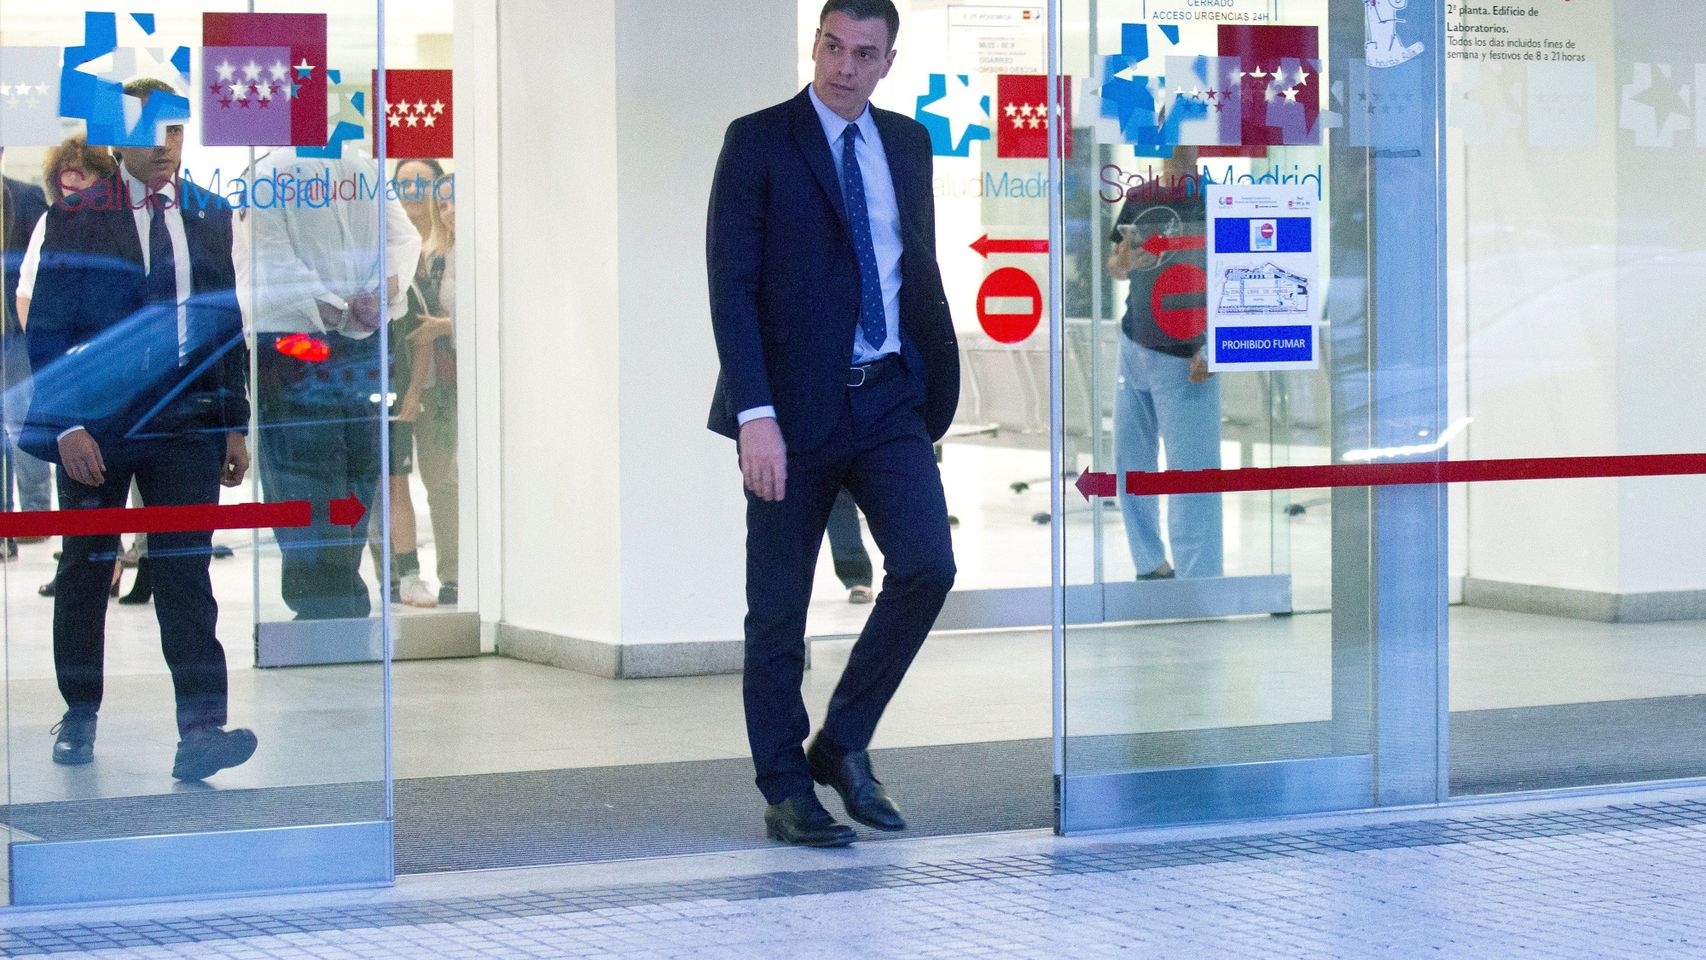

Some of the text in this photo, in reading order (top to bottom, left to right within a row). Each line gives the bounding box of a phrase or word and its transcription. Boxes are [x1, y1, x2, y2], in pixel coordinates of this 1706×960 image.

[1153, 11, 1269, 21] ACCESO URGENCIAS 24H
[1460, 5, 1490, 16] planta.
[1493, 6, 1525, 16] Edificio
[1528, 7, 1539, 16] de
[1447, 22, 1509, 33] Laboratorios.
[1447, 36, 1473, 46] Todos
[1474, 36, 1487, 46] los
[1507, 38, 1541, 48] incluidos
[1543, 39, 1563, 48] fines
[1565, 39, 1576, 49] de
[1447, 51, 1478, 59] semana
[1481, 52, 1487, 60] y
[1489, 50, 1521, 60] festivos
[1523, 51, 1533, 60] de
[1535, 51, 1541, 60] 8
[1551, 52, 1560, 60] 21
[1561, 52, 1585, 61] horas
[1221, 338, 1306, 350] PROHIBIDO FUMAR
